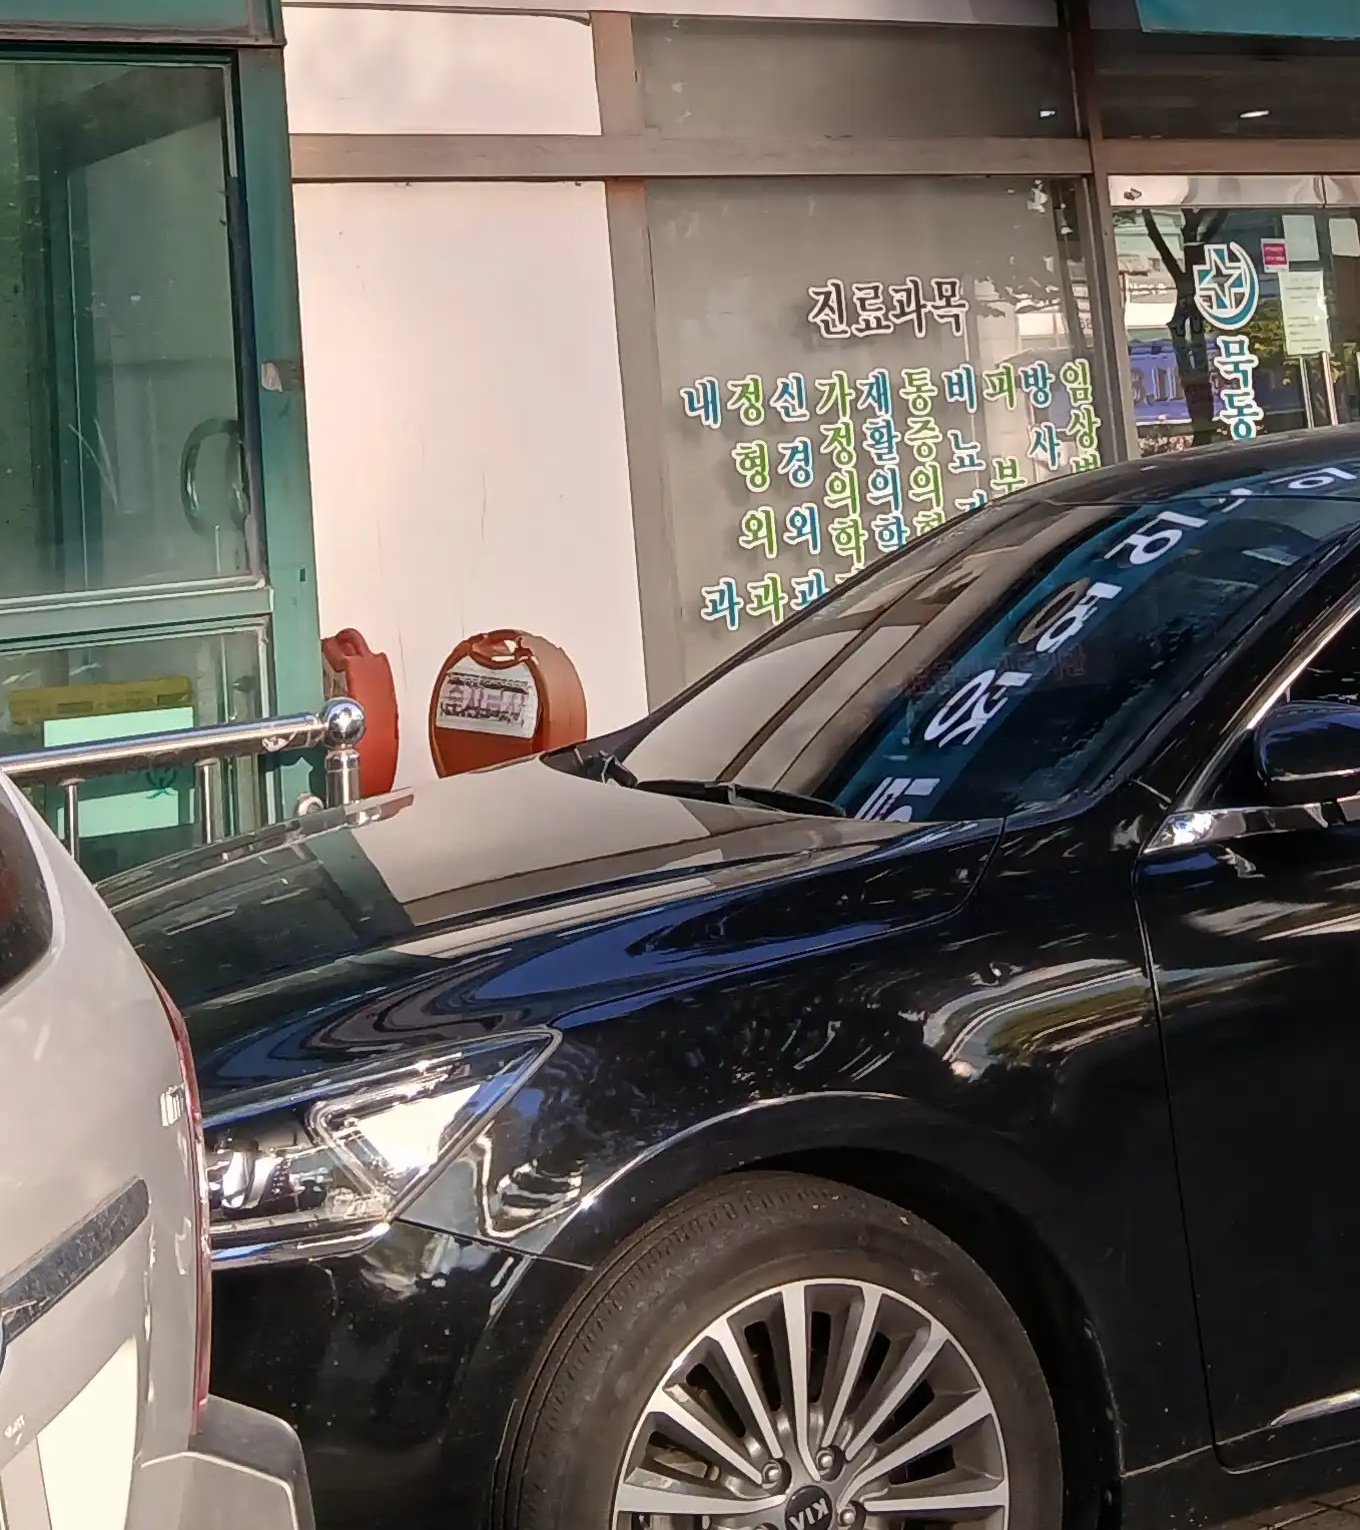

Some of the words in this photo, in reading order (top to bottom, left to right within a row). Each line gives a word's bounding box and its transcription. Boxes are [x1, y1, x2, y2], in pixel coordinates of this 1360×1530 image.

[807, 276, 969, 340] 진료과목
[814, 370, 868, 584] 가정의학
[788, 1497, 830, 1530] KIA
